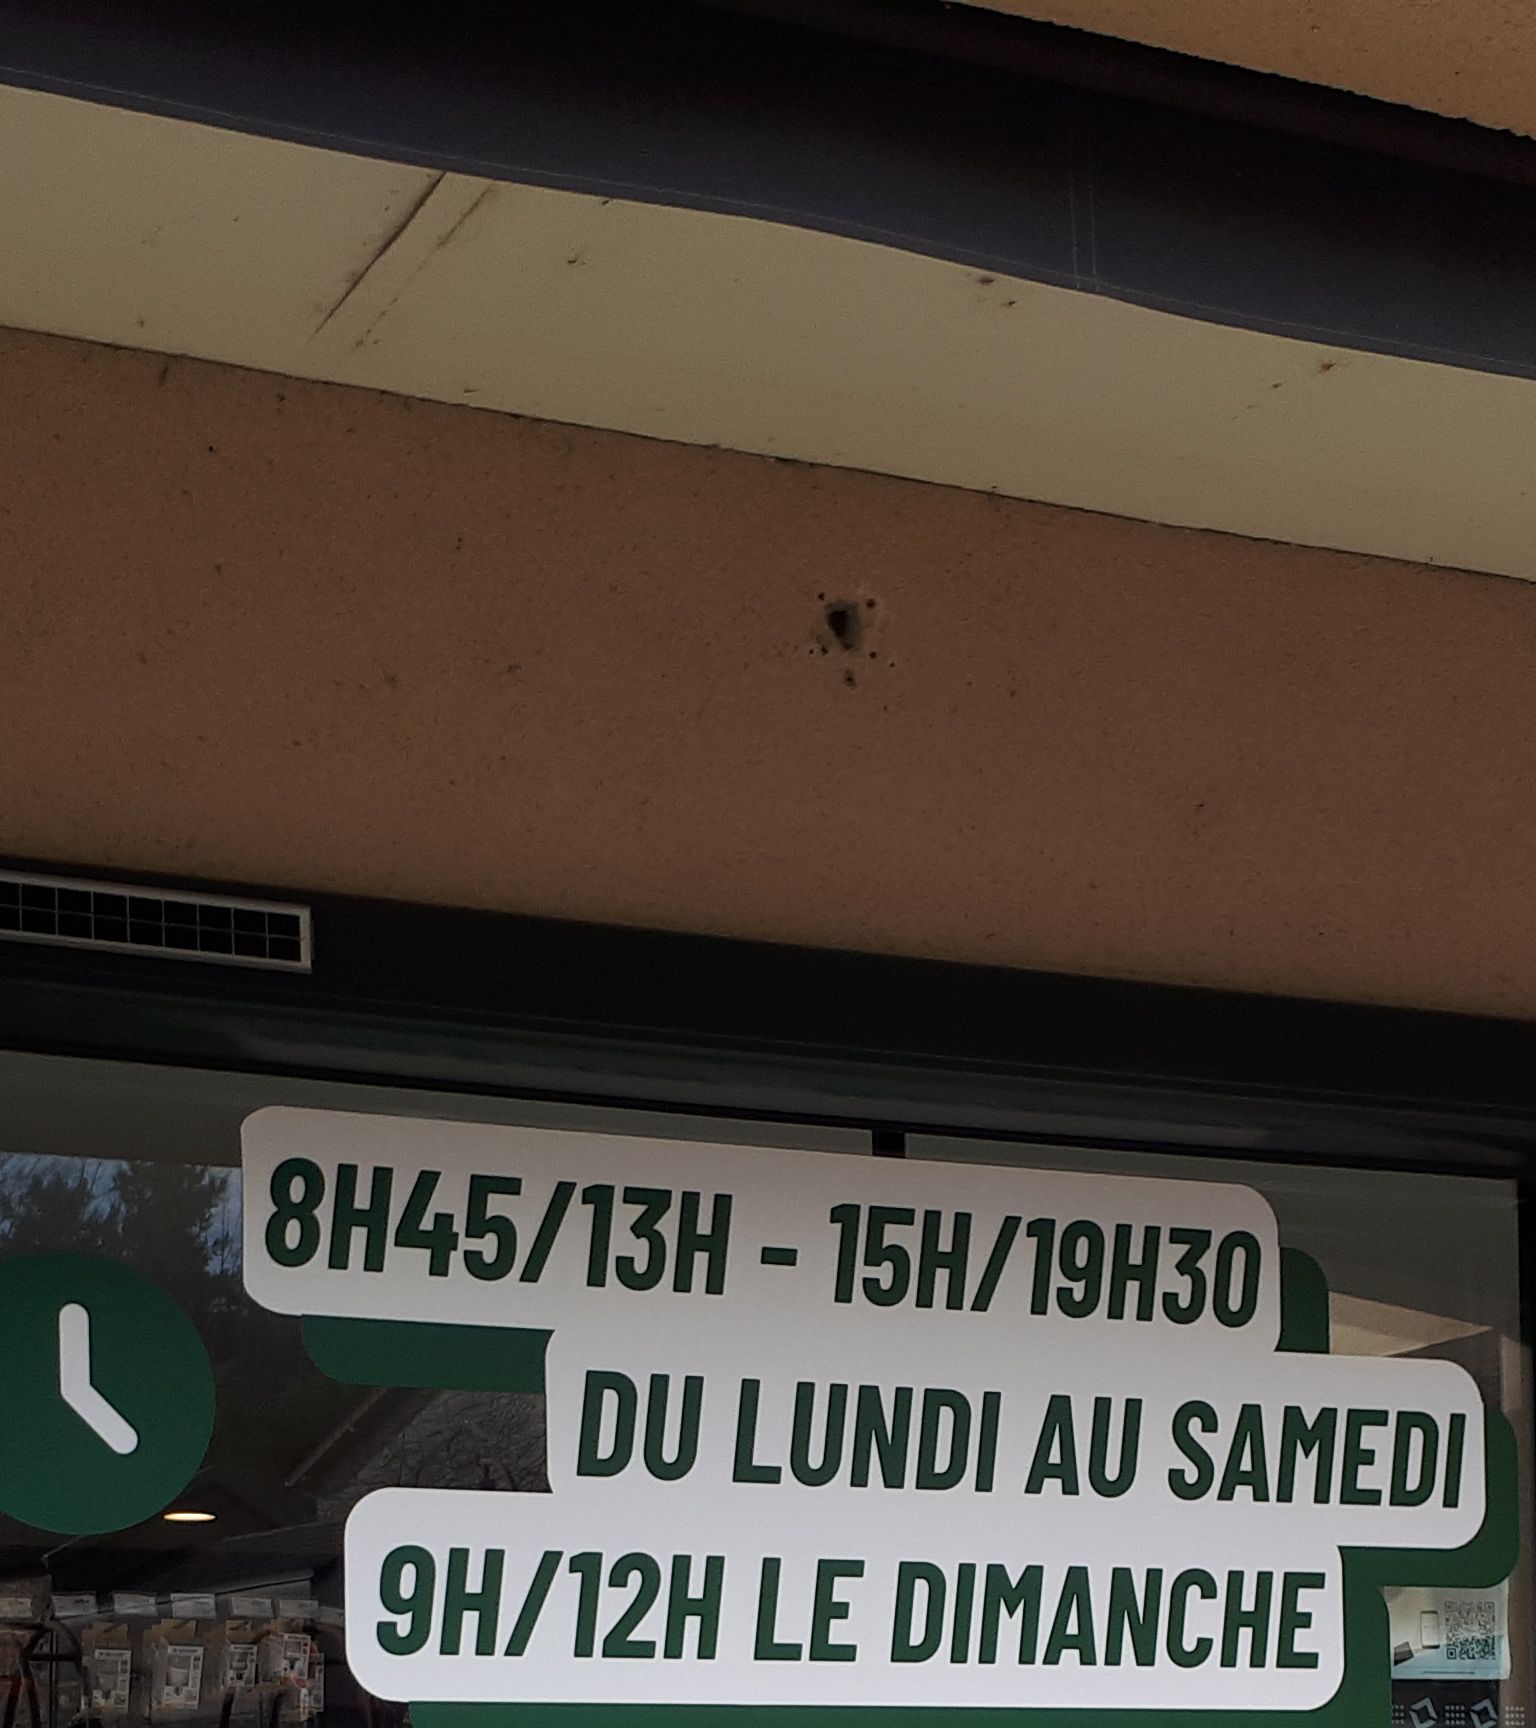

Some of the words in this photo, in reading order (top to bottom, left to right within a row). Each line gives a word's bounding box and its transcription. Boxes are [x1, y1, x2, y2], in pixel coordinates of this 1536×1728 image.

[264, 1156, 734, 1296] 8H45/13H
[759, 1245, 799, 1267] -
[829, 1202, 1262, 1329] 15H/19H30
[576, 1369, 705, 1482] DU
[732, 1377, 1002, 1493] LUNDI
[1023, 1393, 1143, 1499] AU
[1167, 1399, 1467, 1509] SAMEDI
[376, 1544, 726, 1660] 9H/12H
[753, 1556, 865, 1663] LE
[890, 1560, 1326, 1670] DIMANCHE
